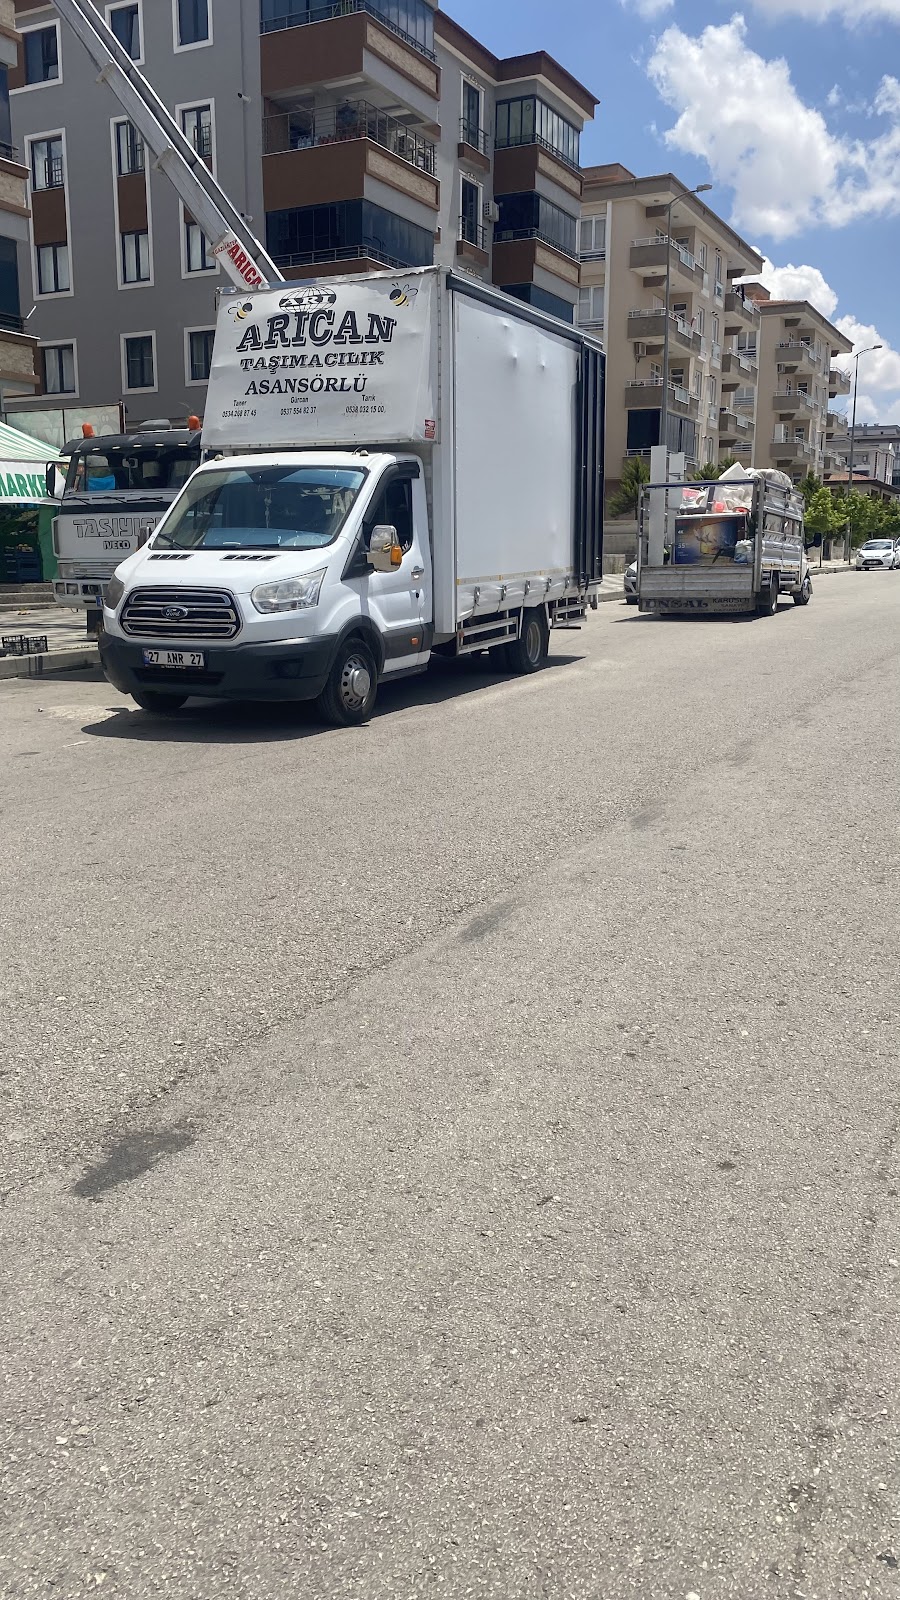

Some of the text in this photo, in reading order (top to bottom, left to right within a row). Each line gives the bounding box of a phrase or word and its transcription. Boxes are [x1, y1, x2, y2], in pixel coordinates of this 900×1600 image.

[227, 244, 262, 285] ARICA
[236, 309, 397, 352] ARICAN
[240, 351, 385, 374] TAŞIMACILIK
[245, 374, 368, 395] ASANSÖRLÜ
[310, 406, 317, 414] 37
[370, 405, 377, 413] 15
[0, 473, 50, 498] ARKE
[103, 540, 131, 550] IVECO
[165, 608, 181, 617] Ford
[148, 651, 202, 665] 27 ANR 27
